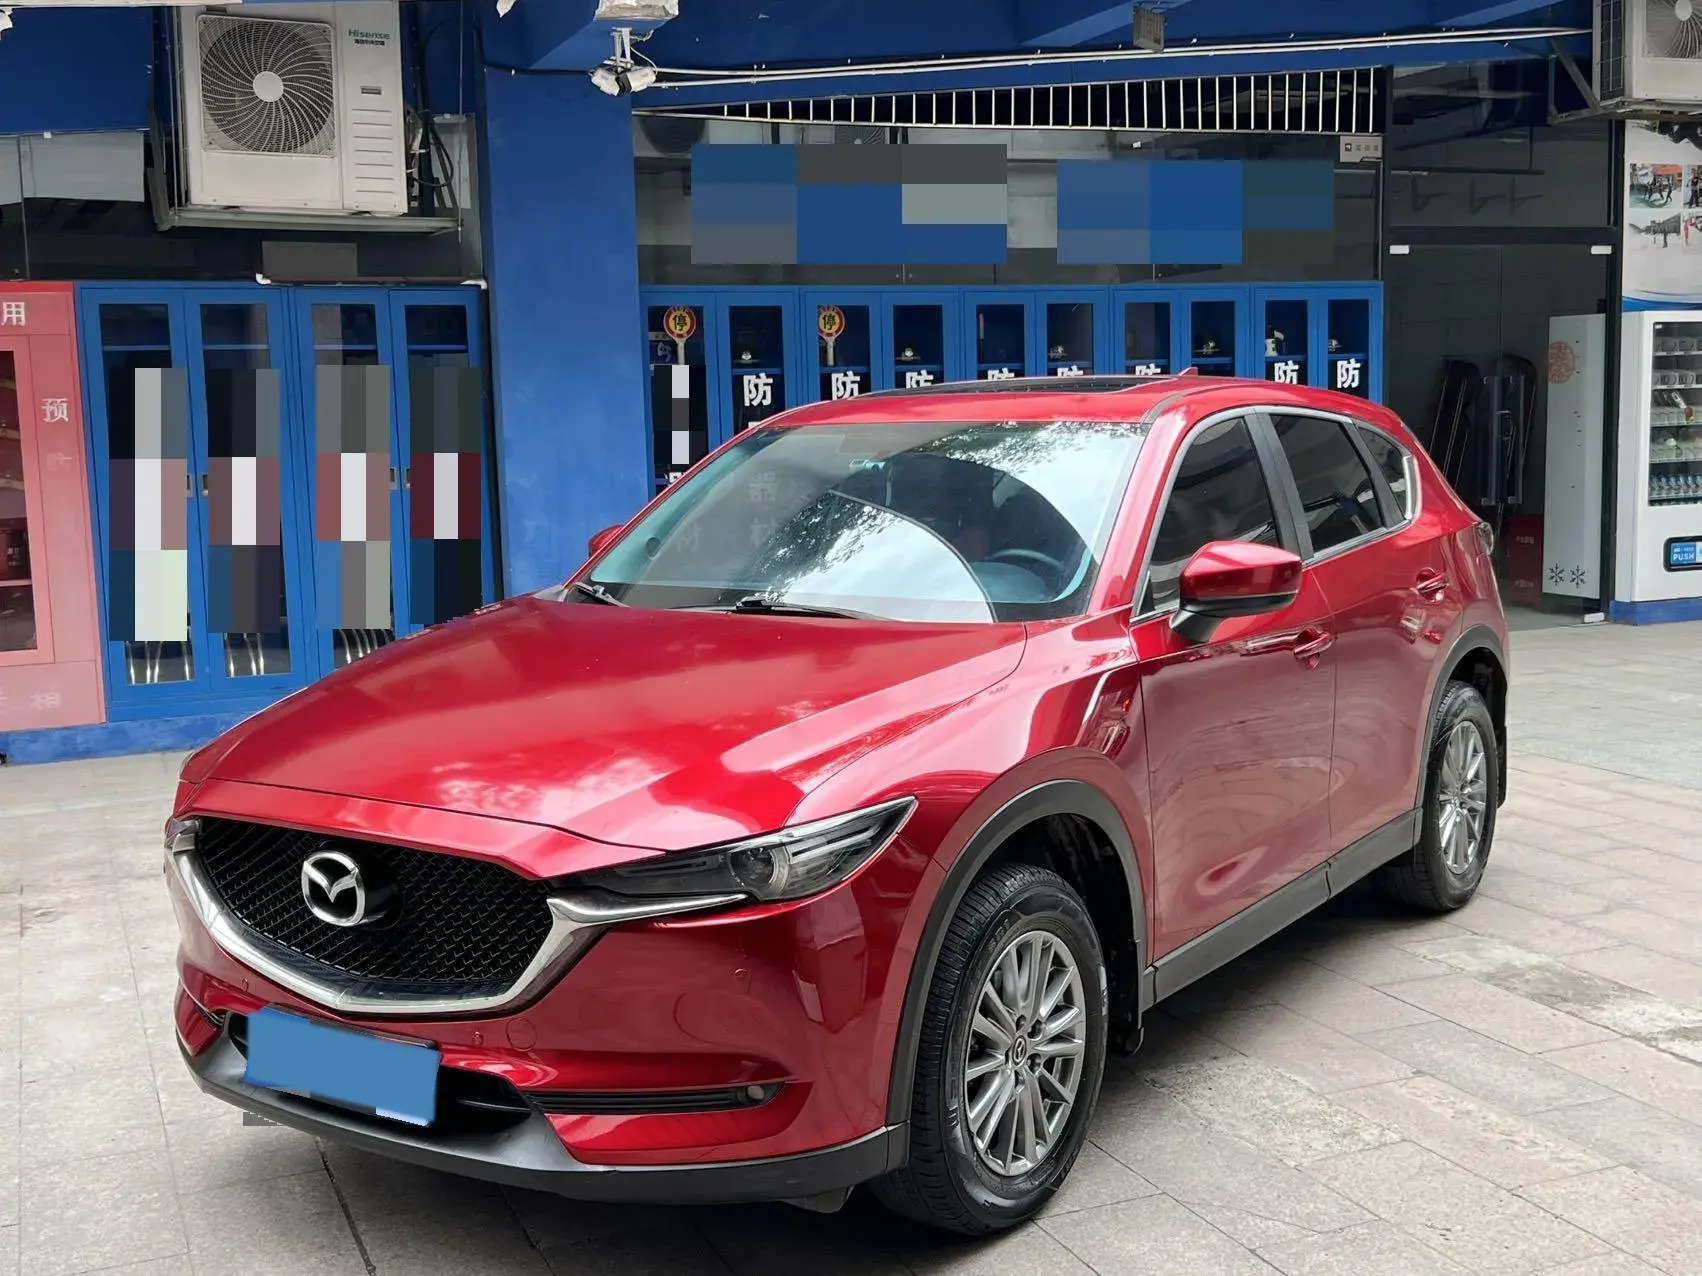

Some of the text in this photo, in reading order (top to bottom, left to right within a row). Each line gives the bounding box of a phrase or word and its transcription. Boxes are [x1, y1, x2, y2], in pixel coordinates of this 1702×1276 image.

[348, 29, 391, 40] Hisense
[1, 301, 26, 327] 用
[672, 313, 688, 331] 停
[822, 312, 837, 330] 停
[1274, 360, 1299, 385] 防
[1337, 358, 1361, 388] 防
[743, 372, 773, 407] 防
[831, 370, 860, 401] 防
[41, 398, 69, 423] 预
[1672, 552, 1695, 561] PUSH
